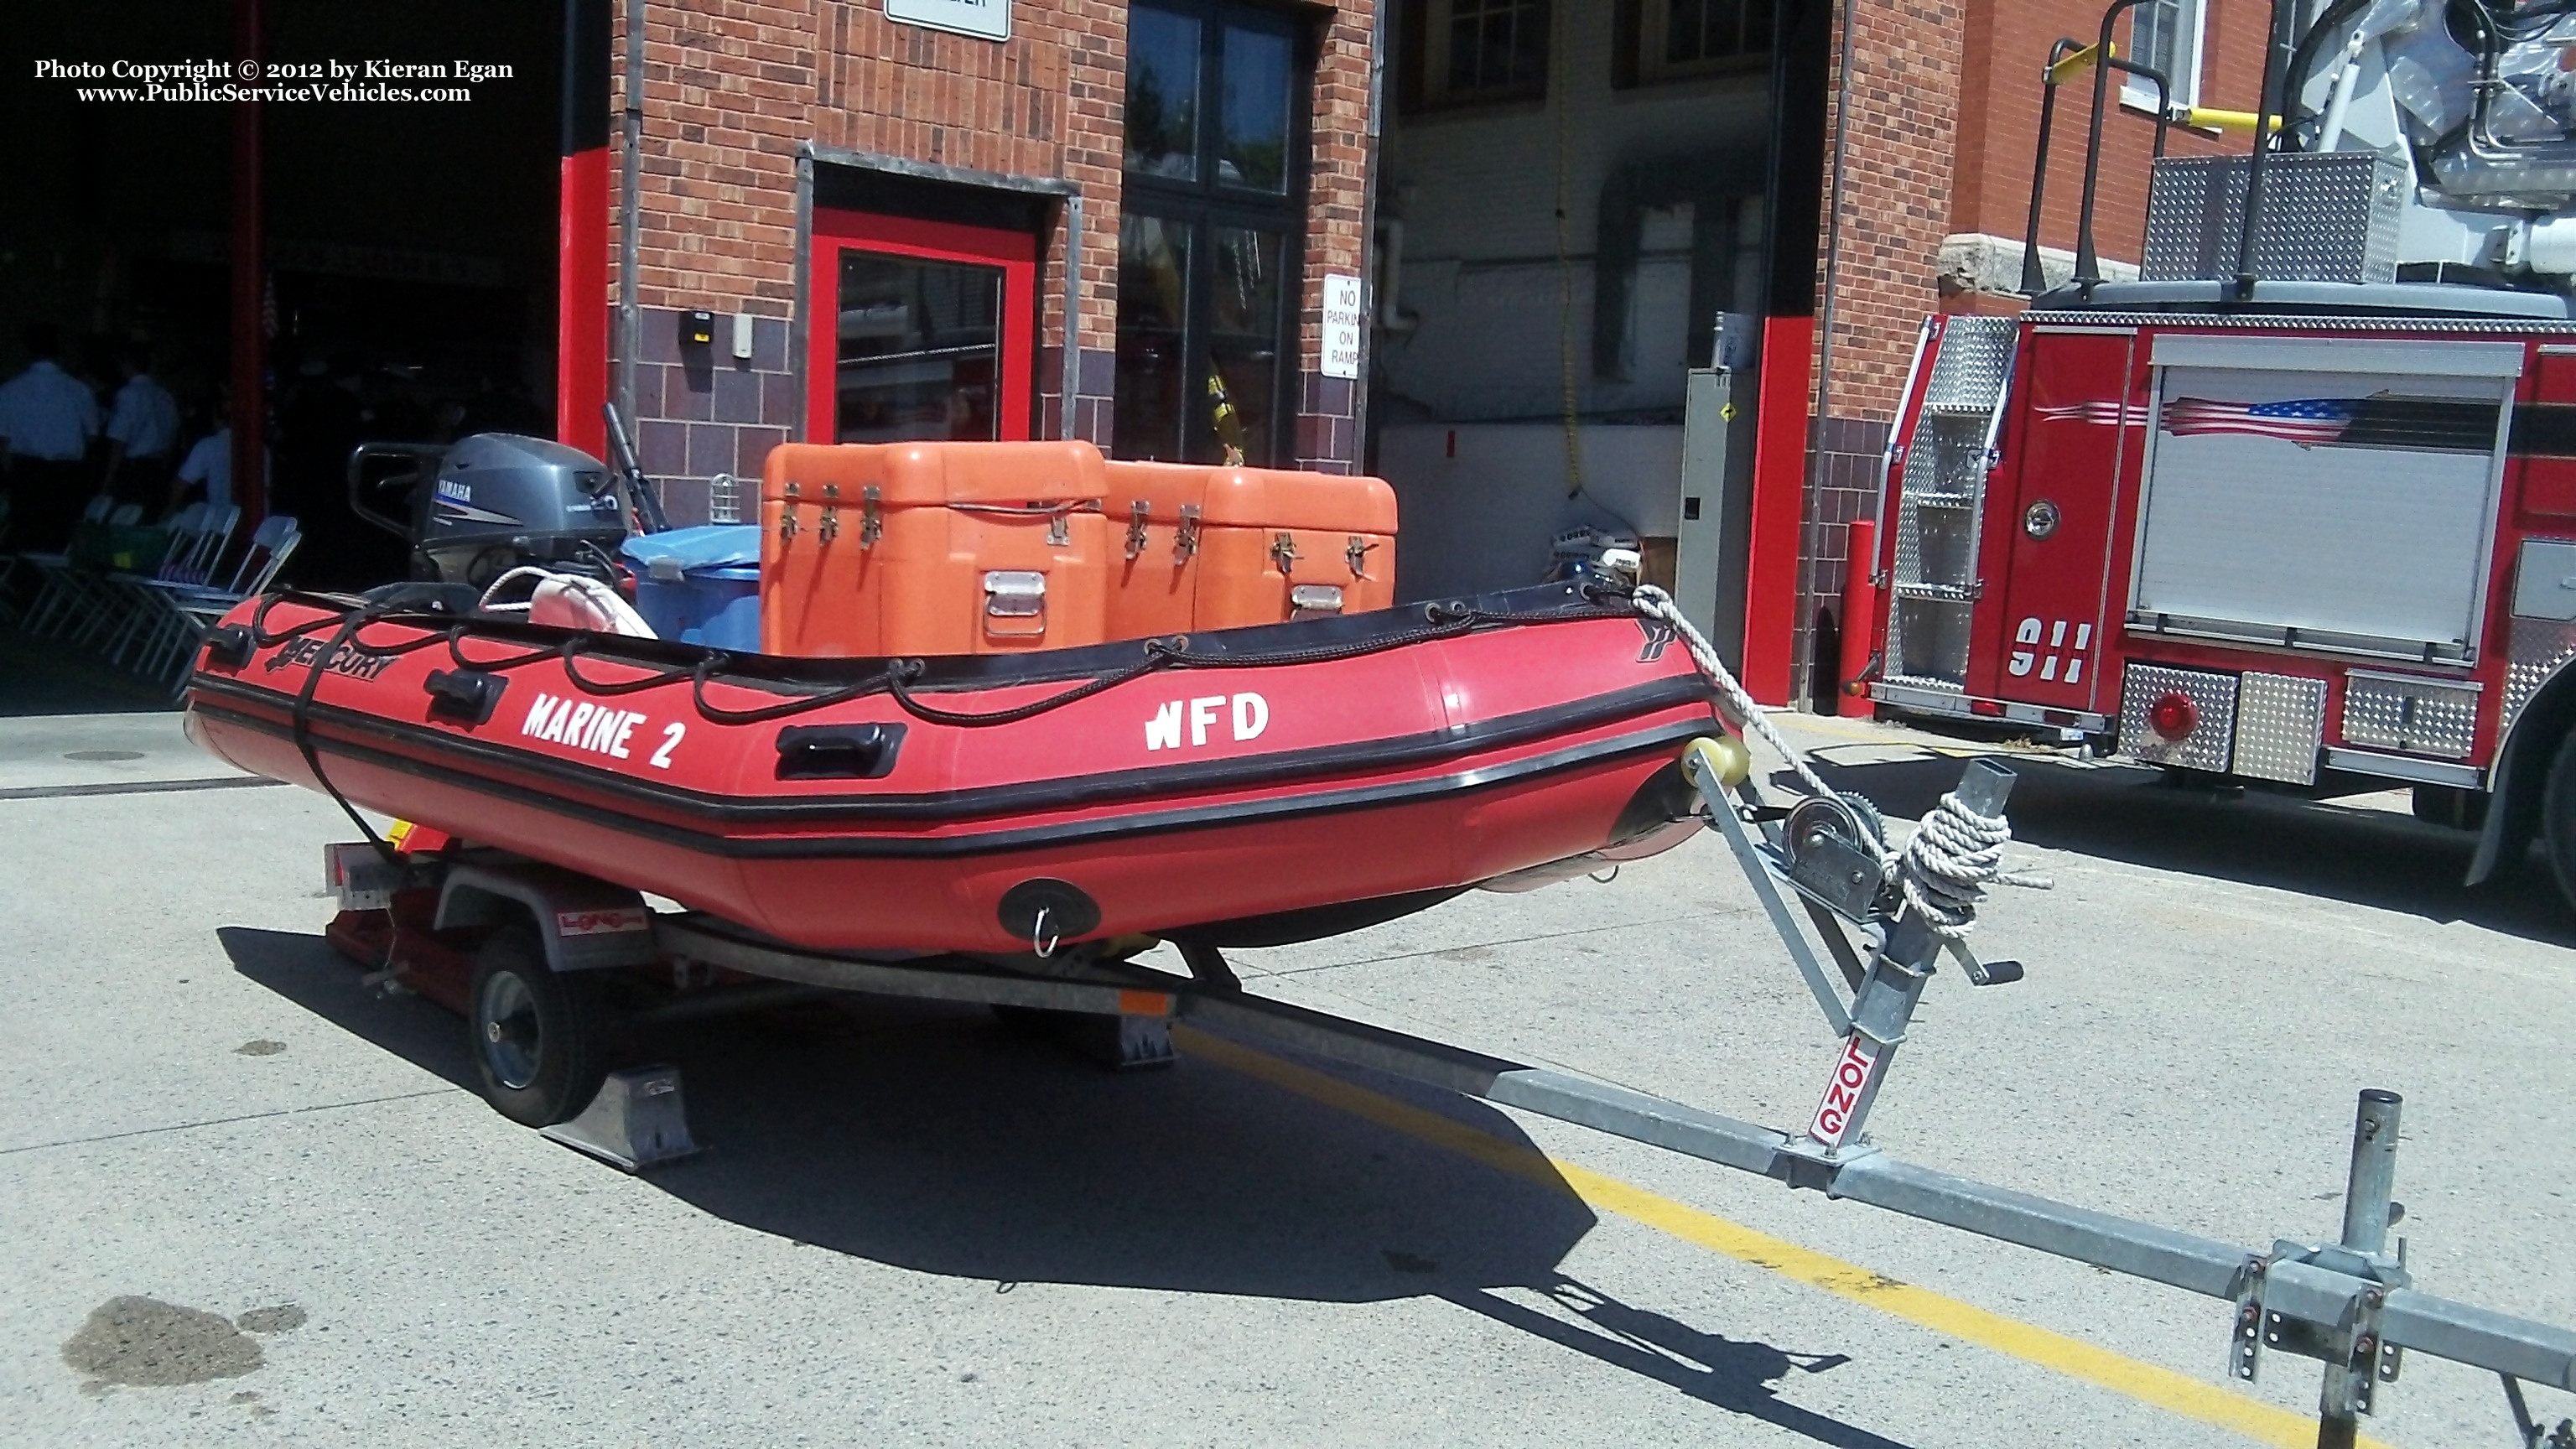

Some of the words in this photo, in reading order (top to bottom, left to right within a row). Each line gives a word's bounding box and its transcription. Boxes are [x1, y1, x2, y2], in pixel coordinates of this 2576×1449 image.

[1339, 290, 1356, 307] NO
[1327, 310, 1359, 326] PARKIN
[1339, 331, 1353, 345] ON
[1332, 350, 1358, 365] RAMP
[438, 479, 471, 503] YAMAHA
[264, 635, 402, 682] MECURY
[2008, 616, 2092, 684] 911
[522, 693, 647, 760] MARINE
[649, 722, 687, 770] 2
[1145, 691, 1270, 751] WFD
[1819, 1036, 1869, 1135] LONG
